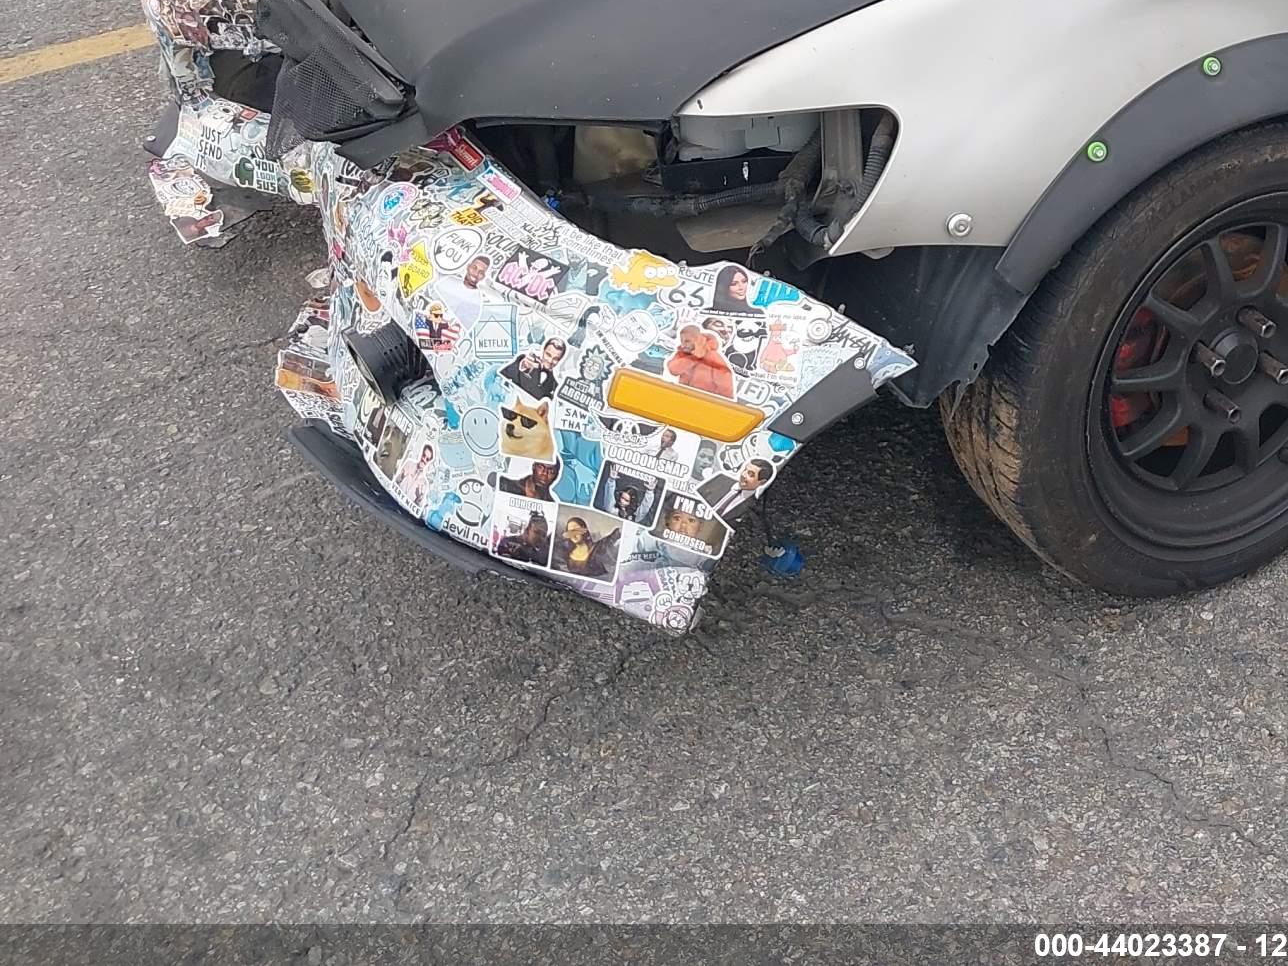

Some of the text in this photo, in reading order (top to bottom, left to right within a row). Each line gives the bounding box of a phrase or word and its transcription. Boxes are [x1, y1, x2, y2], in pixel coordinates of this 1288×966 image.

[201, 125, 221, 144] JUST
[199, 140, 223, 160] SEND
[254, 159, 275, 173] YOU
[255, 172, 277, 182] LOOK
[256, 180, 276, 192] SUS
[486, 232, 519, 256] SOCIA
[560, 237, 613, 265] sometimes
[583, 233, 602, 249] like
[602, 242, 624, 260] that
[677, 266, 715, 284] ROUTE
[478, 338, 509, 349] NETFLIX
[561, 385, 603, 412] ARGUING
[564, 408, 588, 421] SAW
[560, 418, 590, 432] THAT
[656, 459, 690, 479] SNAP
[405, 497, 421, 515] NICE
[673, 495, 714, 521] I'M SO
[443, 516, 471, 539] devil
[662, 527, 706, 552] CONFUSED
